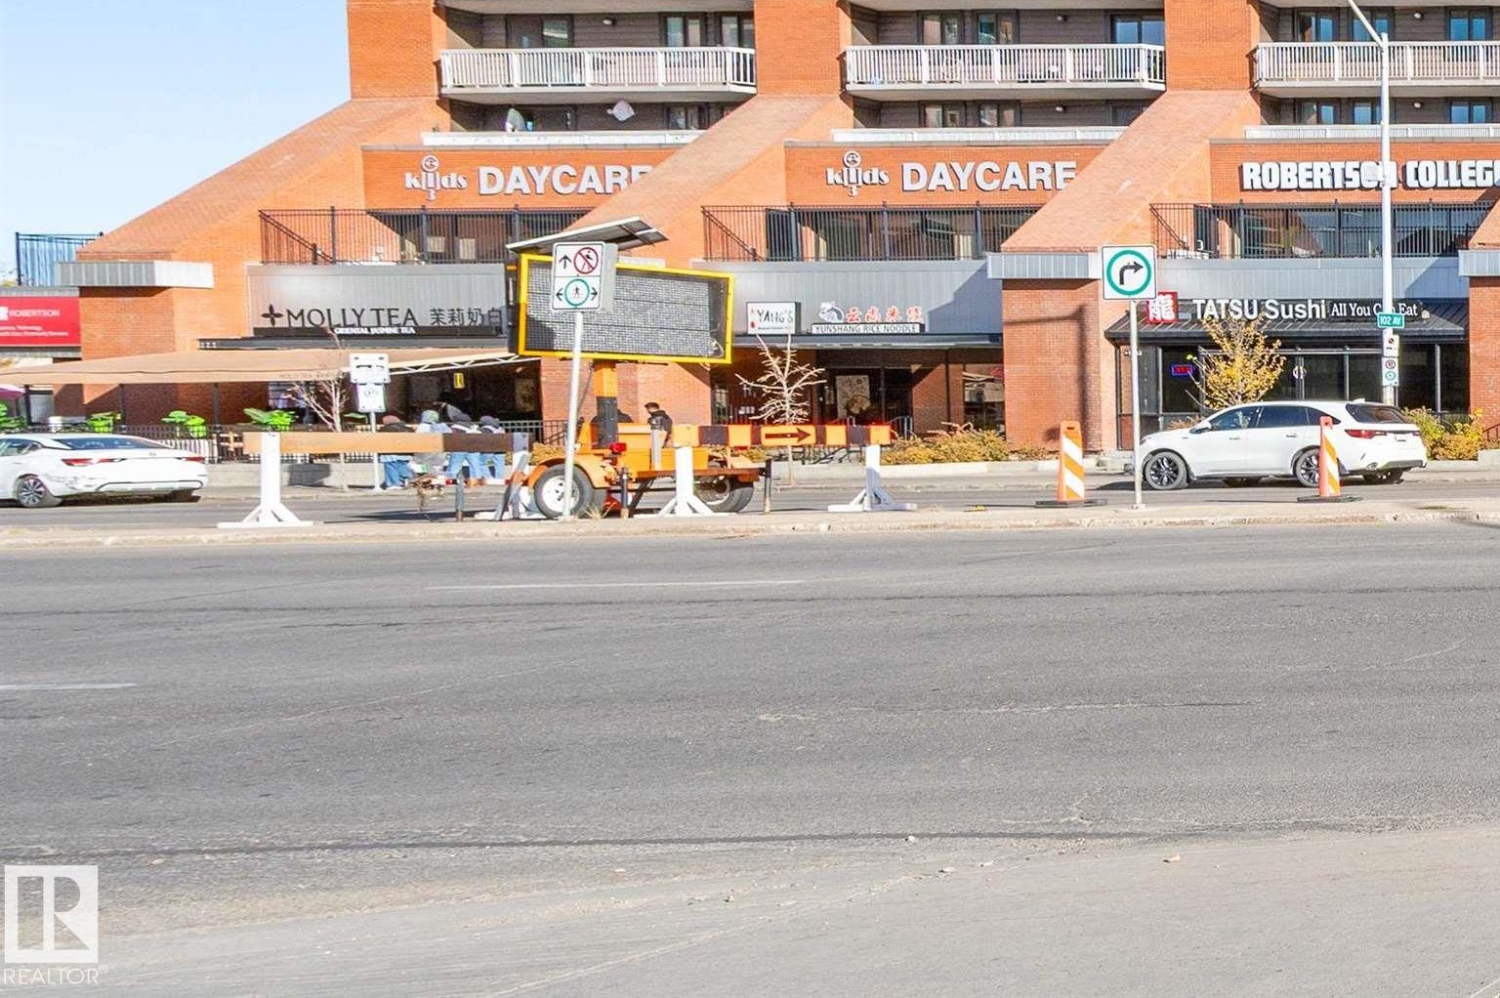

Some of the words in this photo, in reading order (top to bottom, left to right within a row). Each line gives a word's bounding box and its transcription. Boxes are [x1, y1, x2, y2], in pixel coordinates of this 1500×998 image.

[286, 308, 365, 327] MOLLY
[370, 308, 419, 327] TEA
[429, 307, 503, 326] 茉莉奶白
[1193, 299, 1257, 319] TATSU
[1265, 299, 1326, 319] Sushi
[1331, 303, 1347, 316] All
[1349, 303, 1371, 316] You
[1398, 303, 1418, 316] Eat
[816, 324, 860, 333] YUNSHANG
[863, 324, 881, 333] RICE
[883, 324, 916, 333] NOODLE
[1380, 316, 1391, 325] 102
